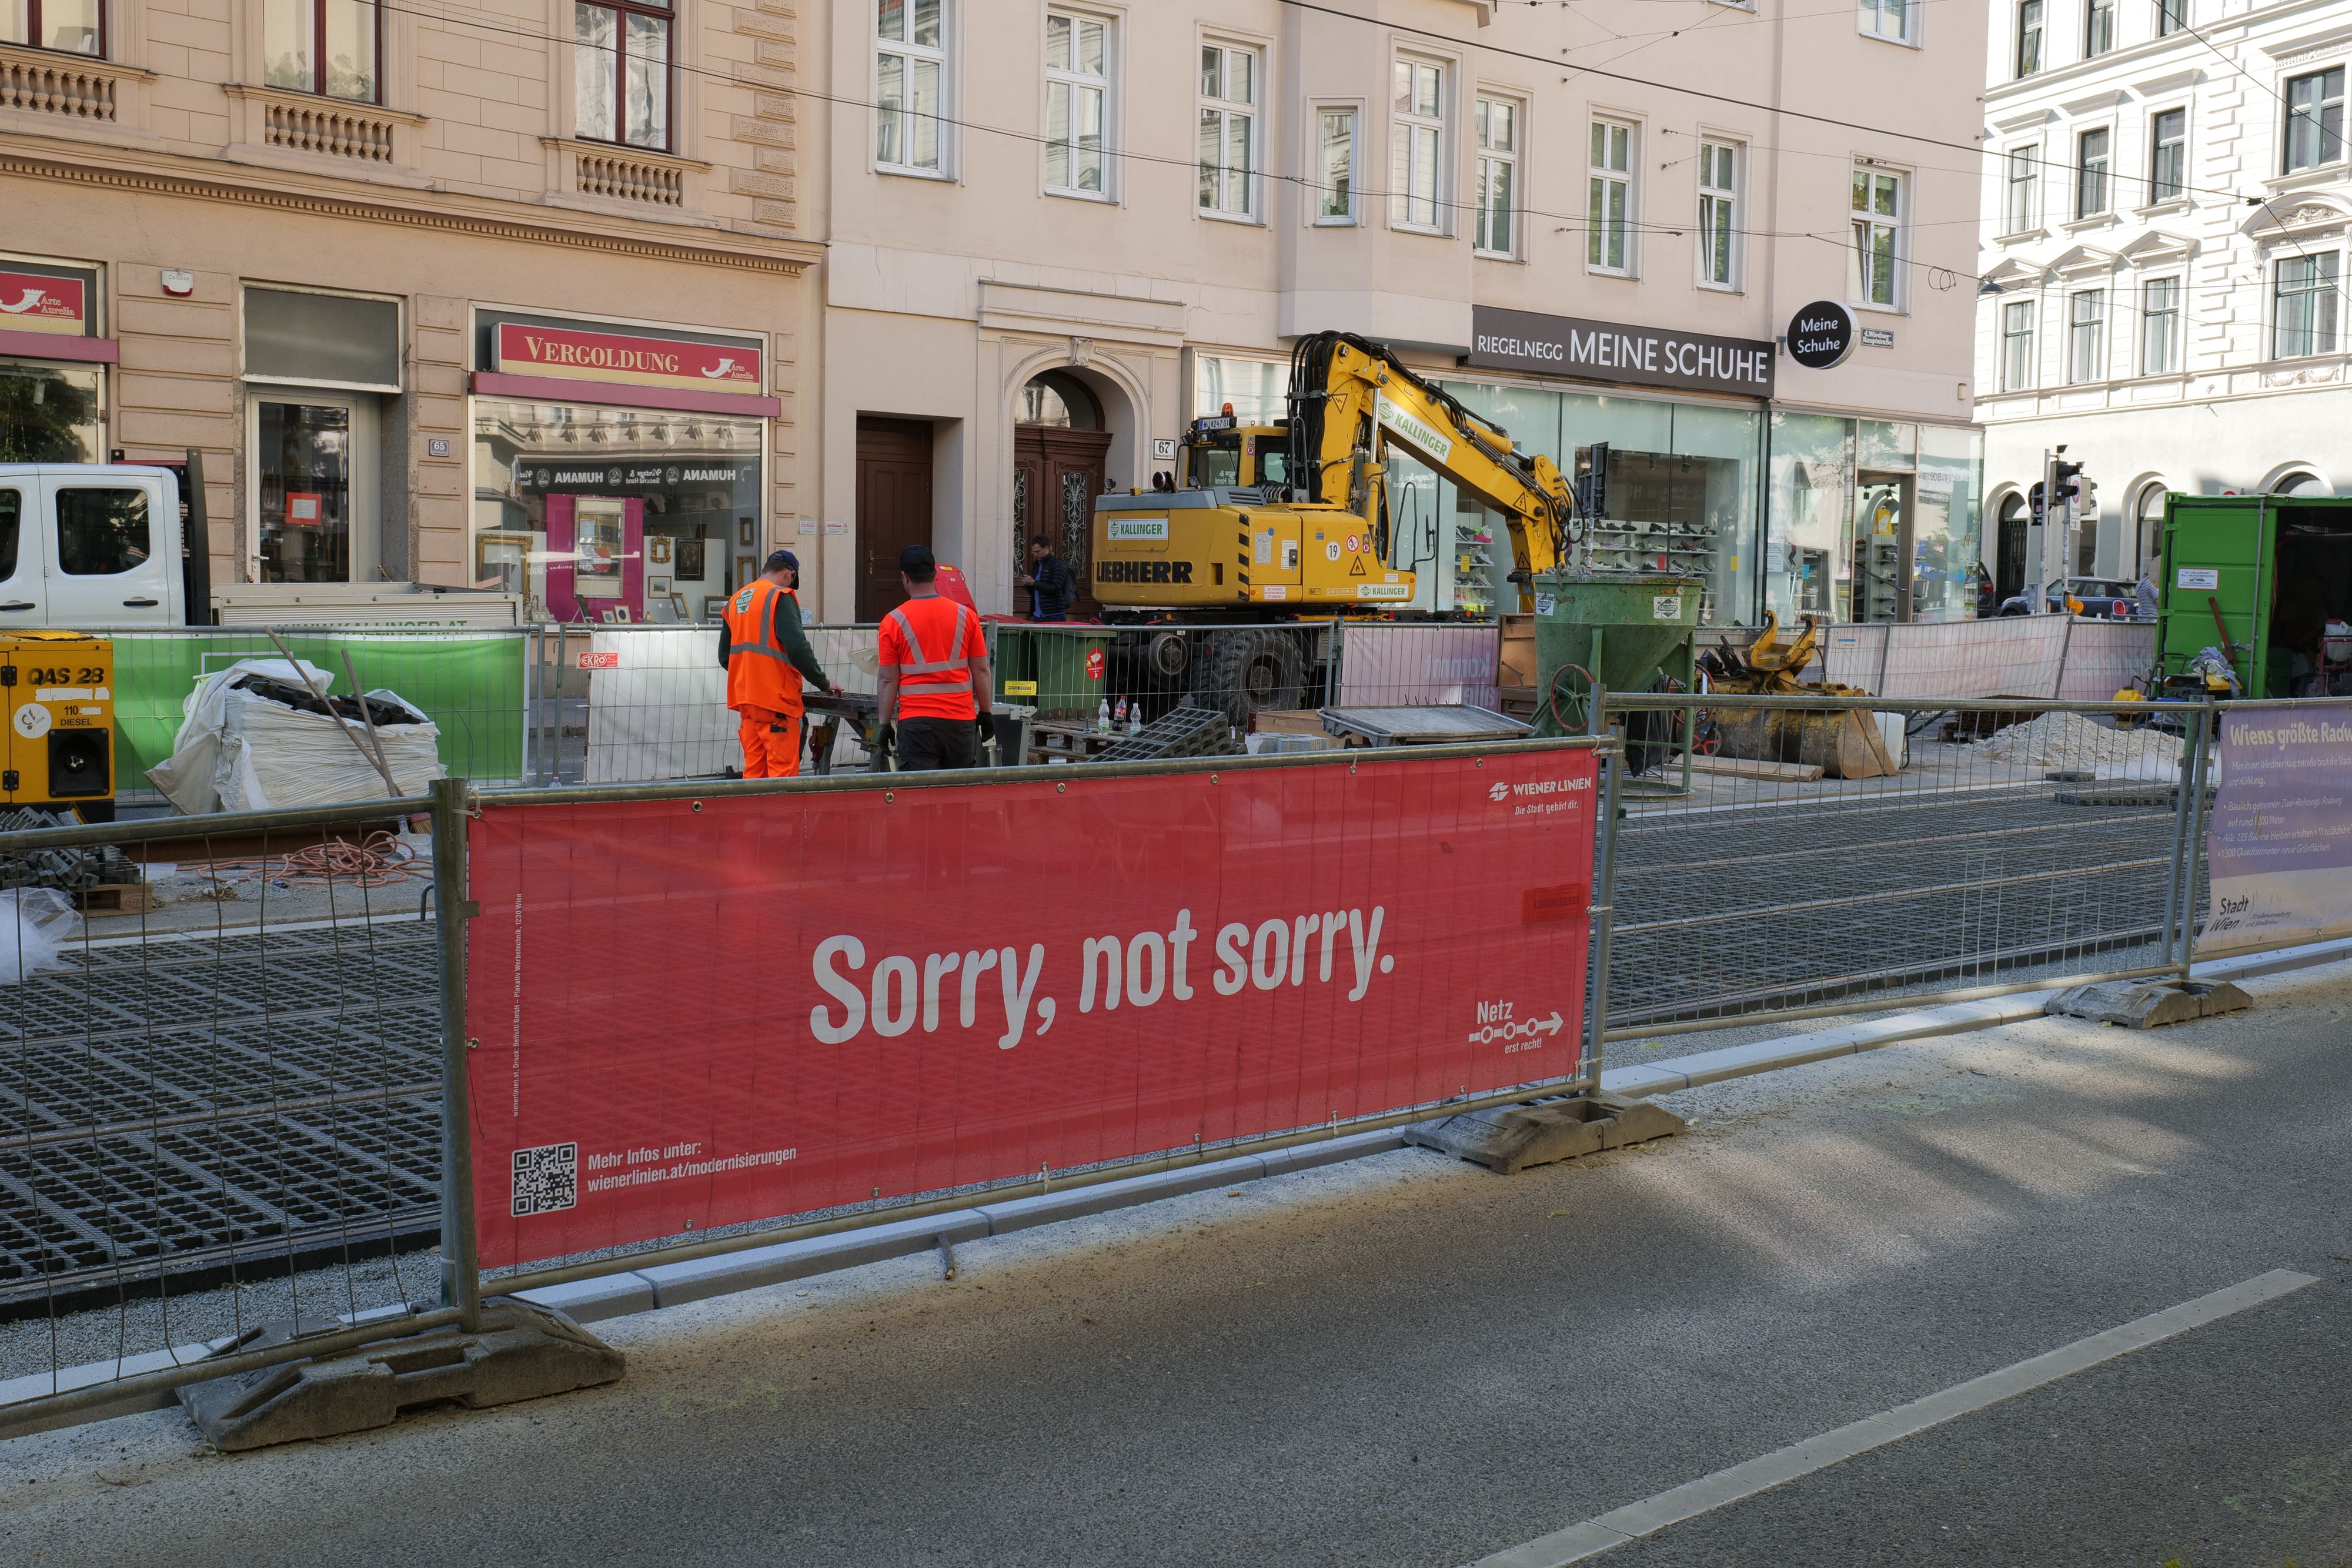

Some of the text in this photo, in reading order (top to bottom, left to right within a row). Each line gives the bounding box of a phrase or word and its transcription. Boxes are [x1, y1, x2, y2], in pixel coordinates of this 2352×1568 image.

[41, 296, 61, 305] Arte
[41, 306, 75, 316] Aurelia
[1801, 318, 1838, 333] Meine
[1798, 337, 1840, 353] Schuhe
[1863, 336, 1892, 346] Hauptstraße
[525, 336, 679, 373] VERGOLDUNG
[1477, 329, 1768, 383] RIEGELNEGG MEINE SCHUHE
[731, 370, 754, 380] Aurelia
[1395, 413, 1447, 457] KALLINGER
[435, 442, 445, 450] 65
[1158, 441, 1171, 453] 67
[1120, 524, 1163, 535] KALLINGER
[1329, 545, 1338, 557] 19
[1096, 561, 1193, 583] LIEBHERR
[1372, 587, 1405, 596] KALLINGER
[581, 654, 606, 667] EKRO
[26, 667, 104, 685] QAS 28
[64, 706, 78, 716] 110
[61, 718, 92, 727] DIESEL
[2230, 724, 2275, 746] Wiens
[2277, 721, 2318, 751] größte
[2250, 761, 2259, 770] der
[2260, 759, 2284, 769] Wiedner
[2285, 757, 2317, 770] Hauptstraße
[2317, 757, 2329, 767] baut
[2338, 755, 2352, 765] Stadt
[1513, 777, 1592, 796] WIENER LINIEN
[2228, 775, 2266, 788] und Kühlung.
[1515, 800, 1579, 815] Die Stadt gehört dir.
[2228, 796, 2342, 813] Baulich getrennter Zwei-Richtungs-Radweg
[2227, 817, 2238, 828] auf
[2238, 817, 2253, 827] rund
[2270, 815, 2285, 825] Meter
[2222, 833, 2235, 842] Alle
[2236, 832, 2247, 842] 135
[2270, 829, 2290, 841] bleiben
[2291, 827, 2313, 838] erhalten
[2324, 825, 2350, 835] zusätzliche
[2236, 847, 2281, 859] Quadratmeter
[2296, 842, 2330, 854] Grünflächen
[2219, 895, 2249, 915] Stadt
[2209, 917, 2240, 932] Wien
[514, 927, 522, 971] Werbetechnik,
[810, 905, 1395, 1050] Sorry, not sorry.
[1477, 999, 1514, 1025] Netz
[1505, 1037, 1542, 1054] erst recht!
[588, 1142, 701, 1171] Mehr Infos unter:
[587, 1147, 797, 1192] wienerlinien.at/modernisierungen
